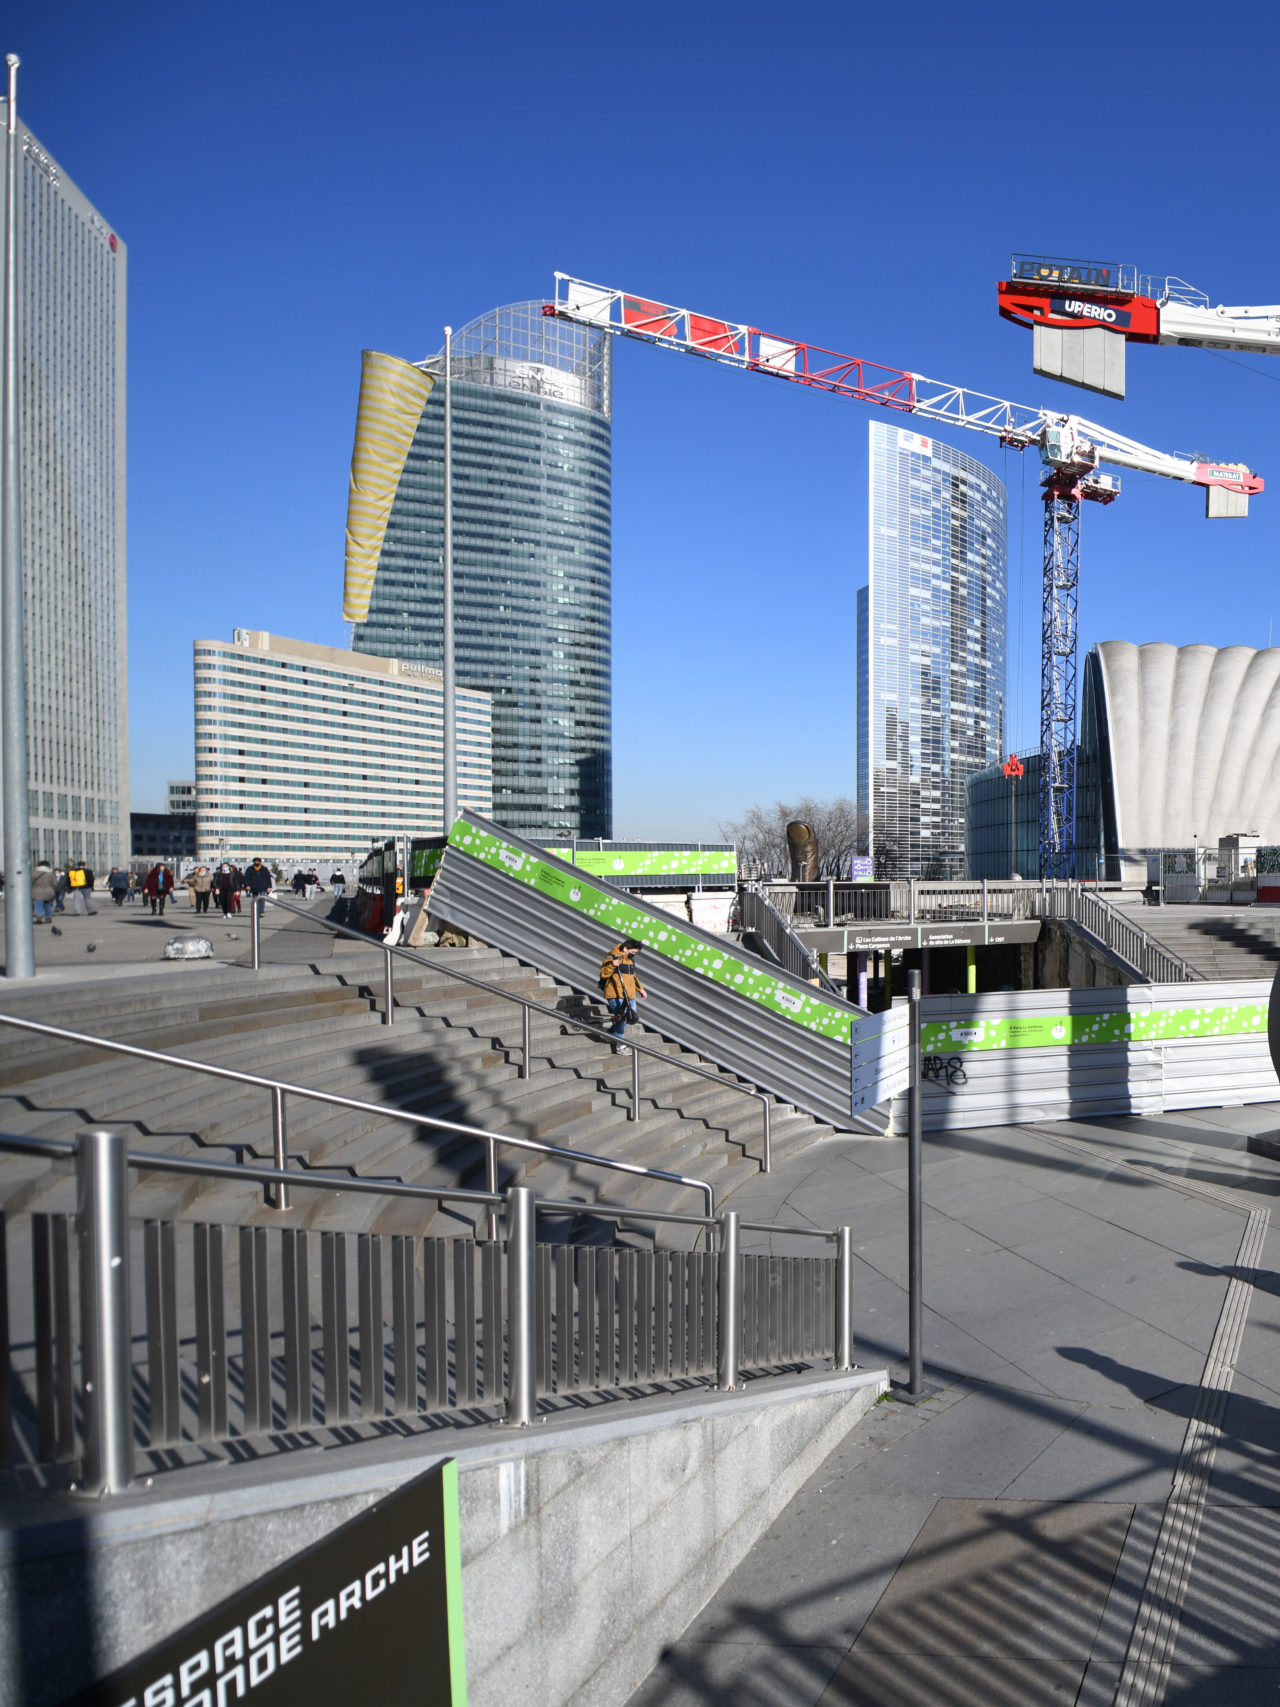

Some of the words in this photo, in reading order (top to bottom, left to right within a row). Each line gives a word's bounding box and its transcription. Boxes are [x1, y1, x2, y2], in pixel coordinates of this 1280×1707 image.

[1019, 260, 1111, 287] POTAIN
[1064, 300, 1116, 323] UPERIO
[310, 1529, 431, 1642] ARCHE
[117, 1584, 302, 1707] SPACE
